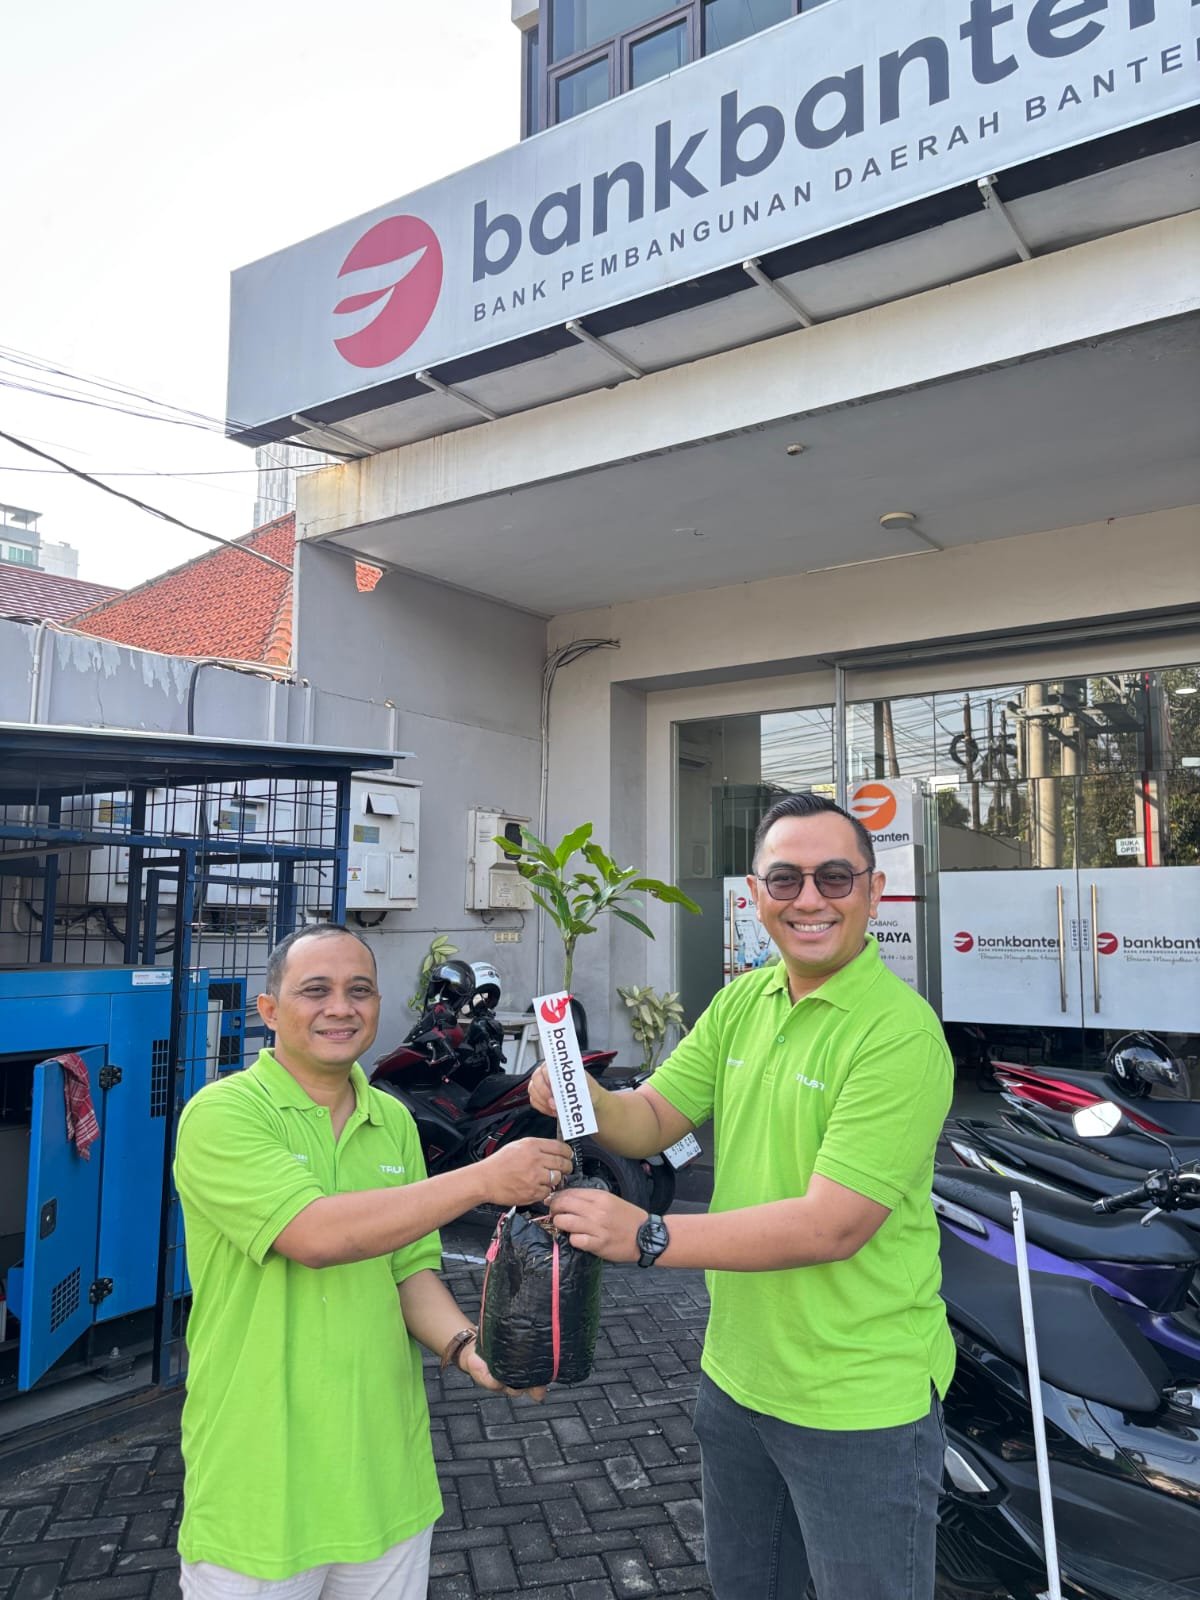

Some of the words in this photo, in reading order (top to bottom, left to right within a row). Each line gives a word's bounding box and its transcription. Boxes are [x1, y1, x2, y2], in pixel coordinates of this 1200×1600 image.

[472, 0, 1200, 283] bankbante
[473, 280, 548, 322] BANK
[561, 182, 812, 291] PEMBANGUNAN
[835, 111, 1000, 192] DAERAH
[1025, 37, 1200, 122] BANTE
[869, 932, 912, 943] BAYA
[553, 1027, 586, 1136] bankbanten
